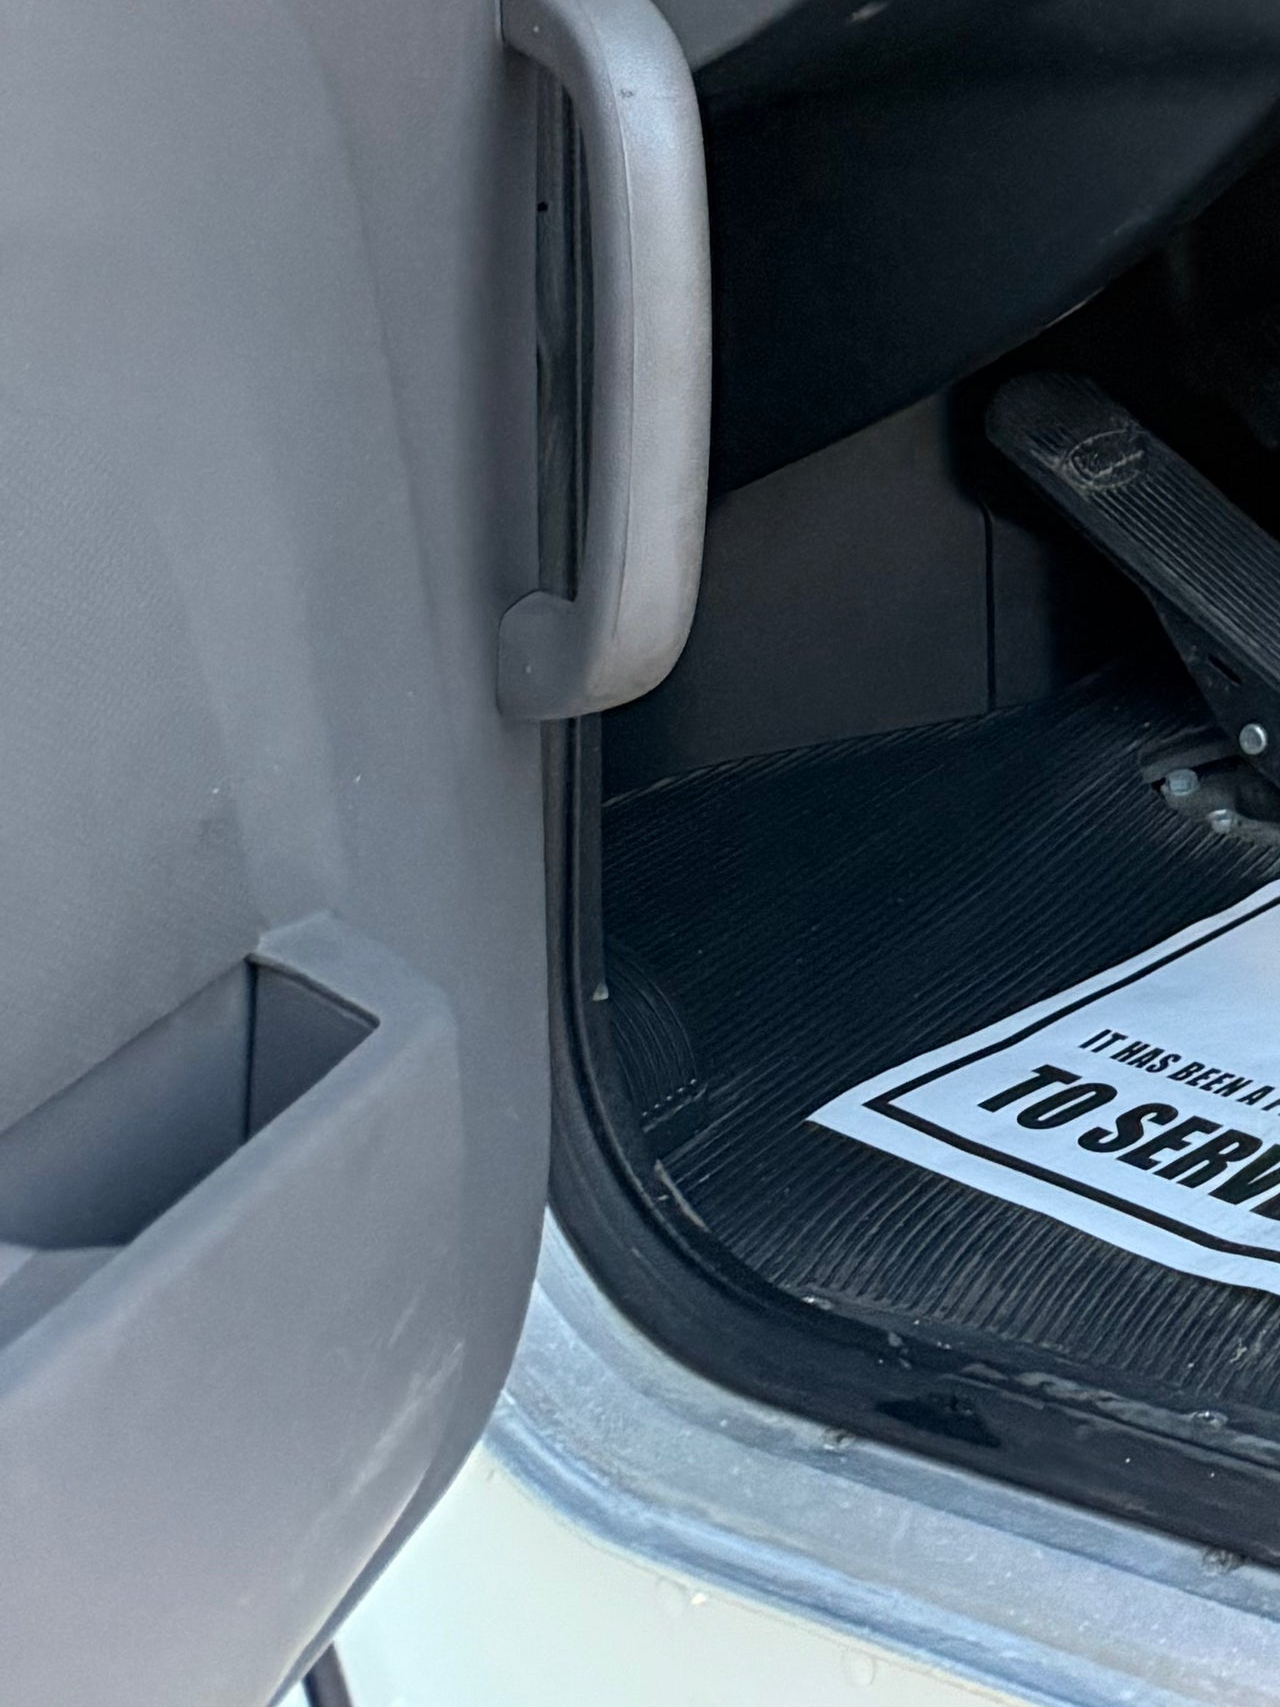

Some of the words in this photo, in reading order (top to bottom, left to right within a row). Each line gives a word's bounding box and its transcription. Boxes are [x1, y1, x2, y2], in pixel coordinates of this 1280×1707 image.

[978, 1066, 1119, 1130] TO
[1078, 1029, 1128, 1054] IT
[1109, 1041, 1183, 1074] HAS
[1166, 1061, 1254, 1098] BEEN
[1237, 1085, 1276, 1106] A
